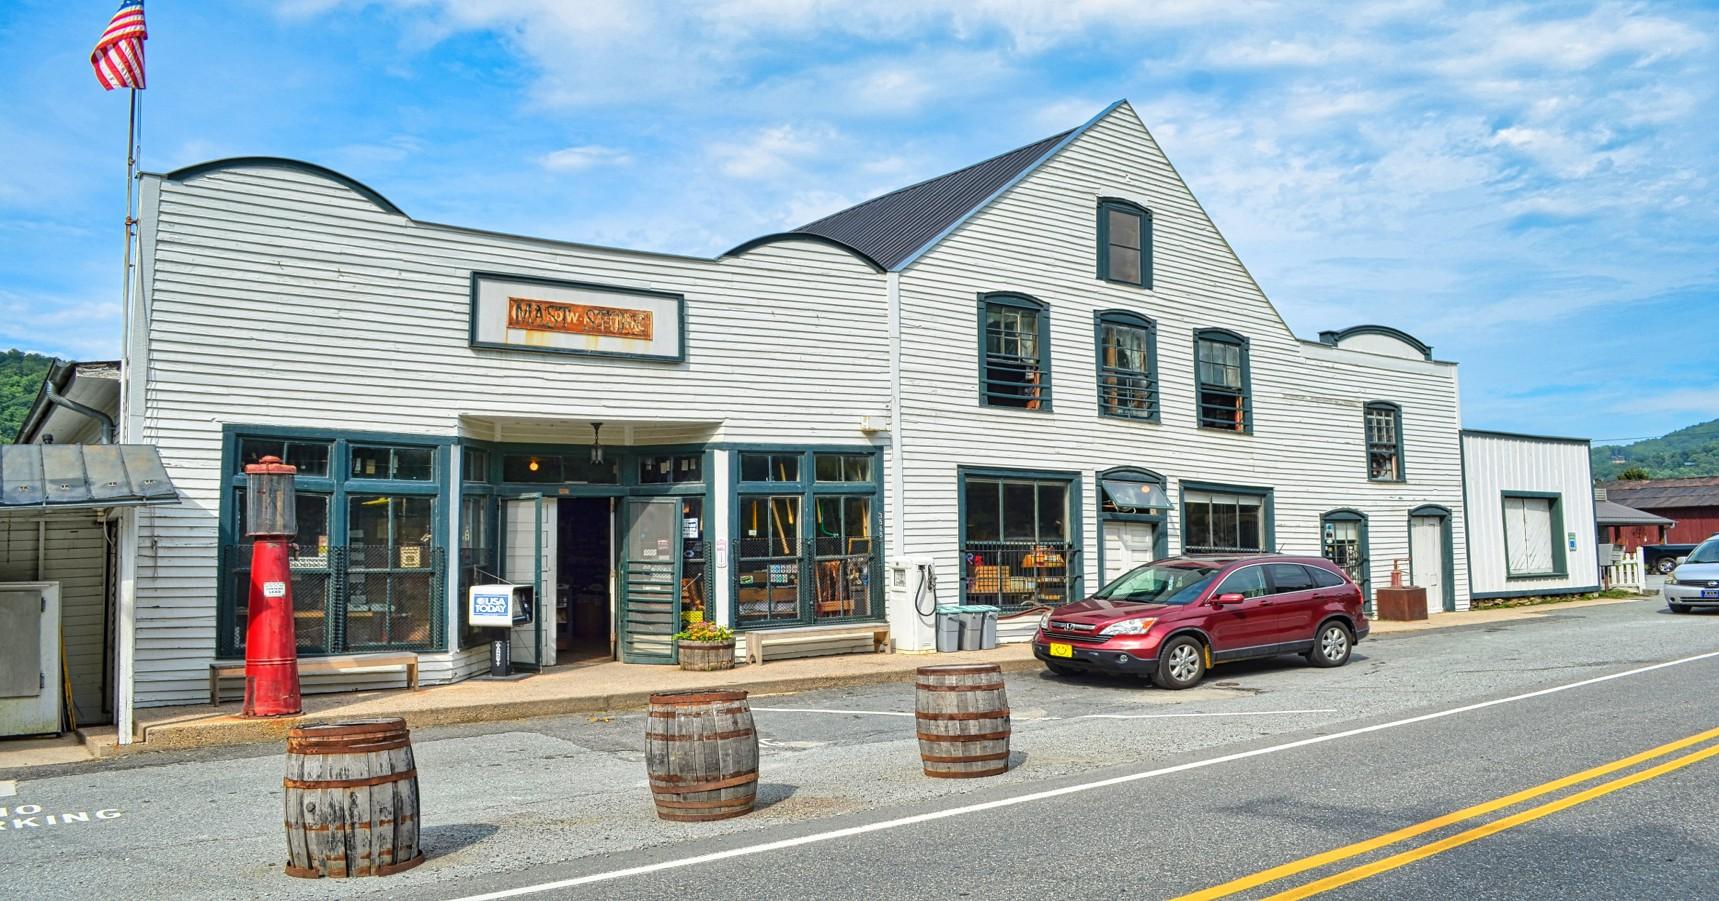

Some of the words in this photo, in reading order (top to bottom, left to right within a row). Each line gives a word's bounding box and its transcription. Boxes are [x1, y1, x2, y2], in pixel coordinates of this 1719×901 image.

[515, 303, 571, 329] MAST
[486, 597, 506, 605] USA
[475, 604, 507, 612] TODAY
